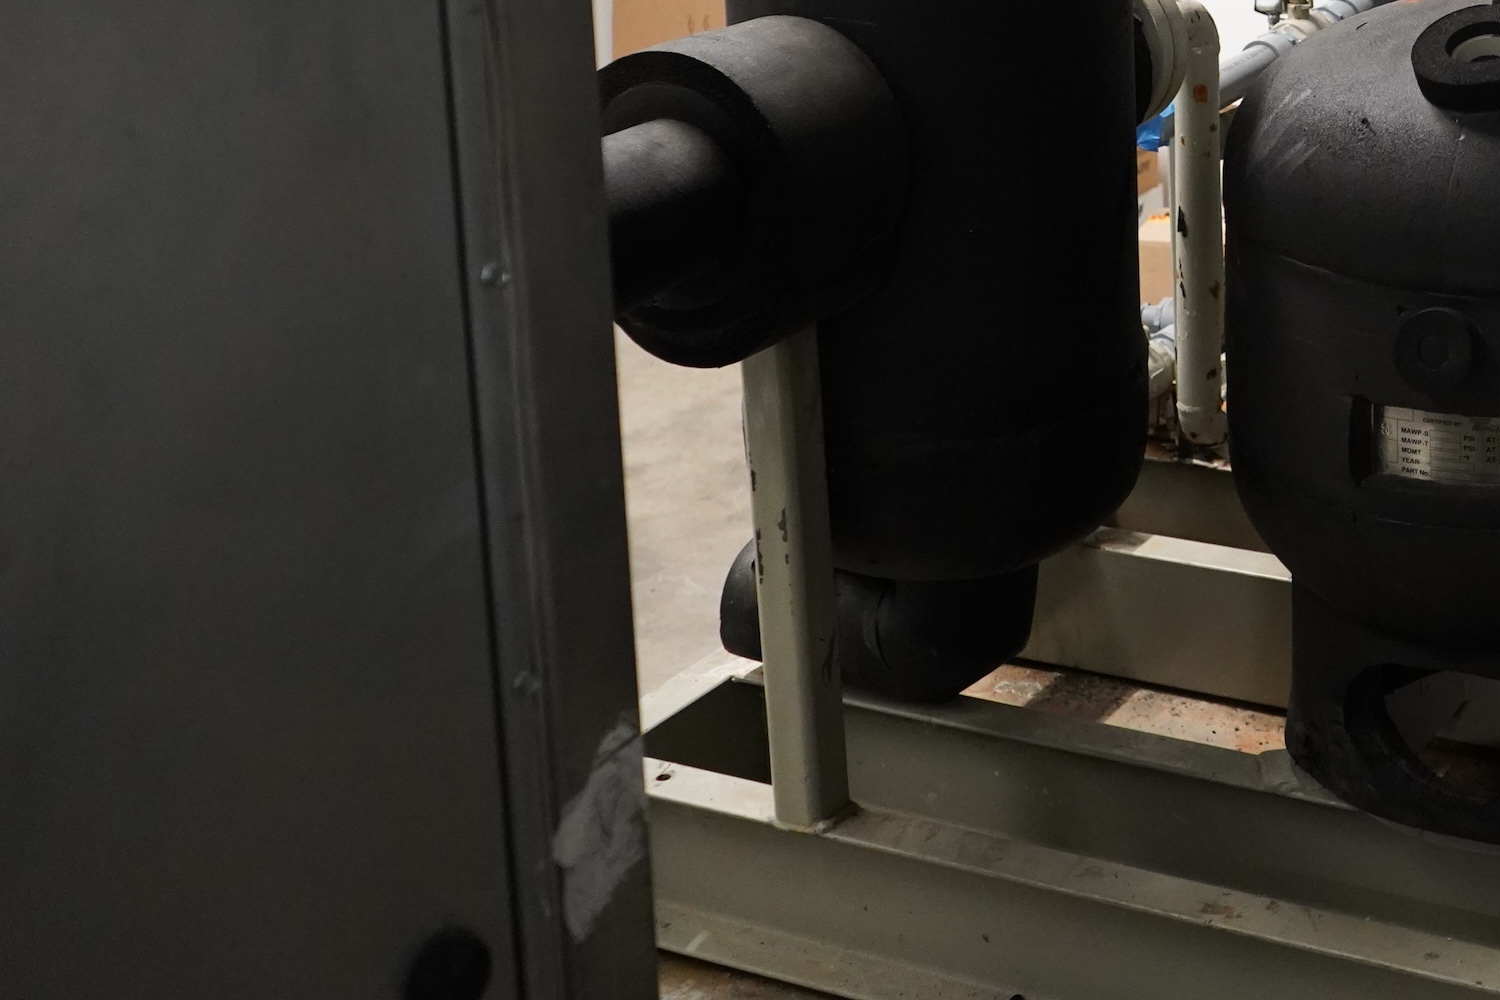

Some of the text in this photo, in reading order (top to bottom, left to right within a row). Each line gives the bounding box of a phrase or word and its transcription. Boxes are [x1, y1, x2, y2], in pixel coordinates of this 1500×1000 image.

[1401, 447, 1422, 455] MDMT
[1401, 456, 1420, 465] YEAR
[1401, 466, 1418, 475] PART
